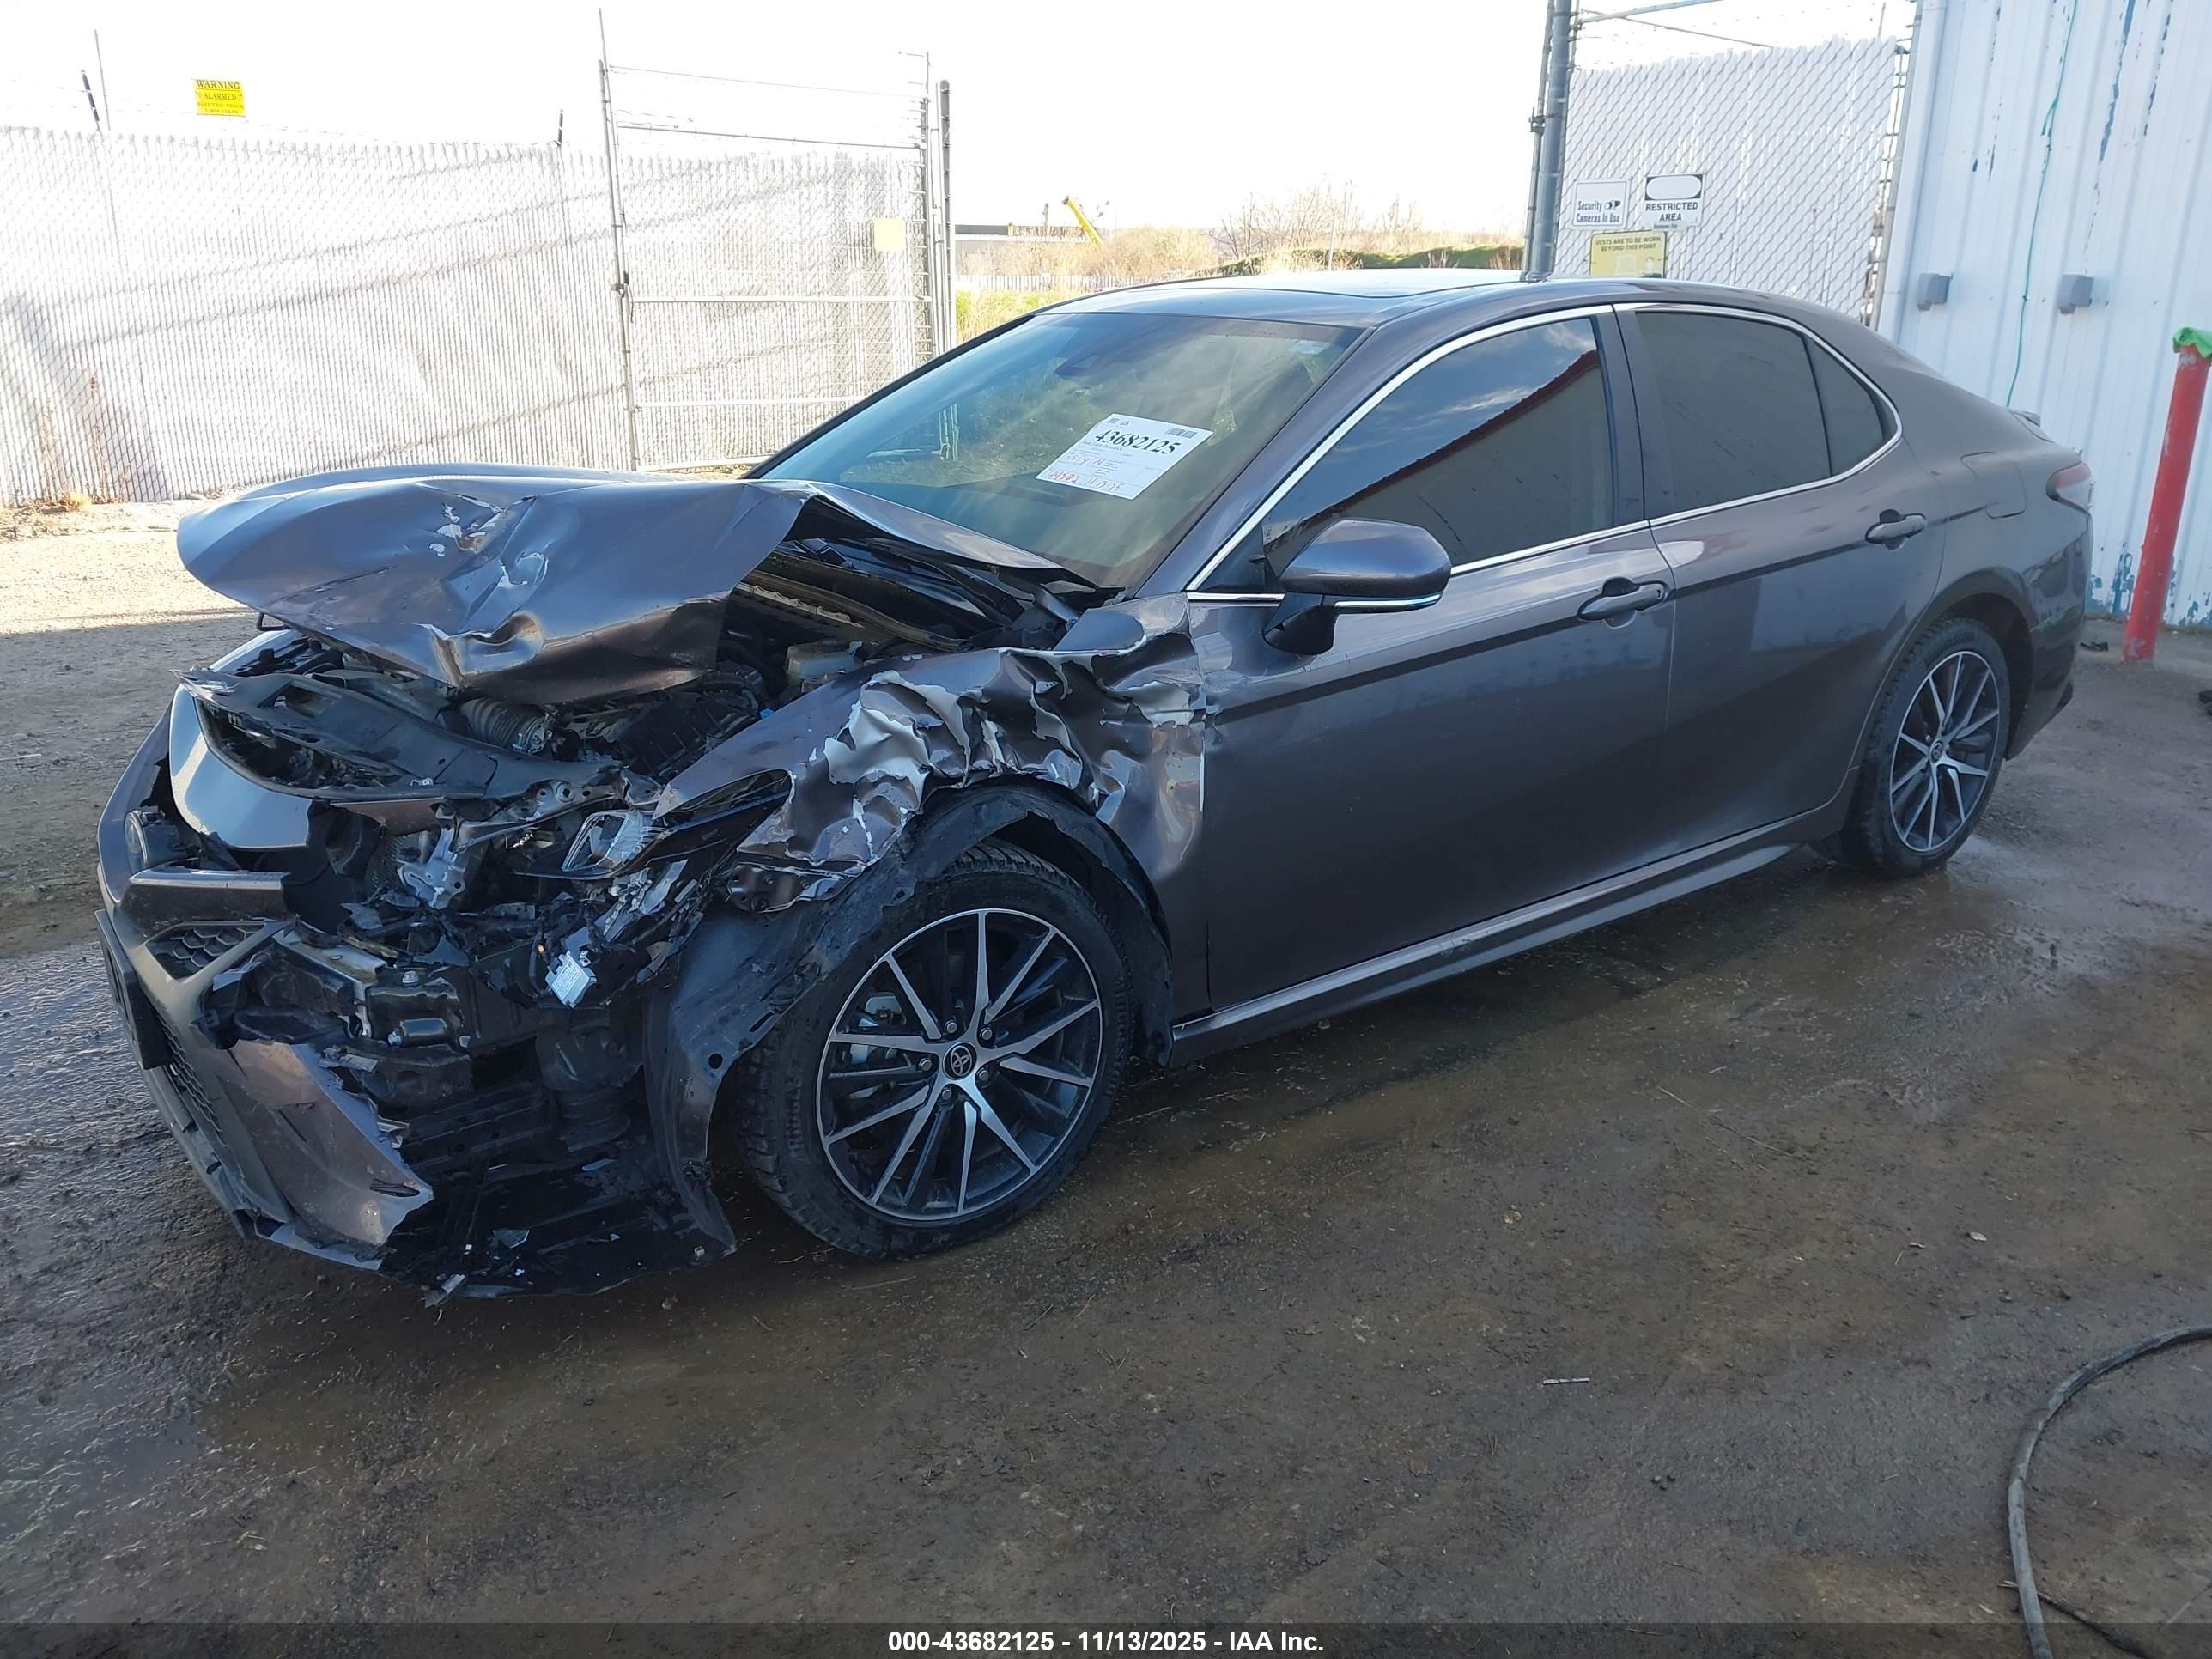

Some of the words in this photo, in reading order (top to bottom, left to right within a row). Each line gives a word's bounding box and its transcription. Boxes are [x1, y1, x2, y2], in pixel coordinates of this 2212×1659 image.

[197, 79, 240, 90] WARNING
[1577, 200, 1602, 213] Security
[1645, 201, 1698, 212] RESTRICTED
[1576, 213, 1601, 223] Cameras
[1609, 212, 1620, 222] Use
[1659, 213, 1682, 222] AREA
[1095, 429, 1182, 455] 43682125
